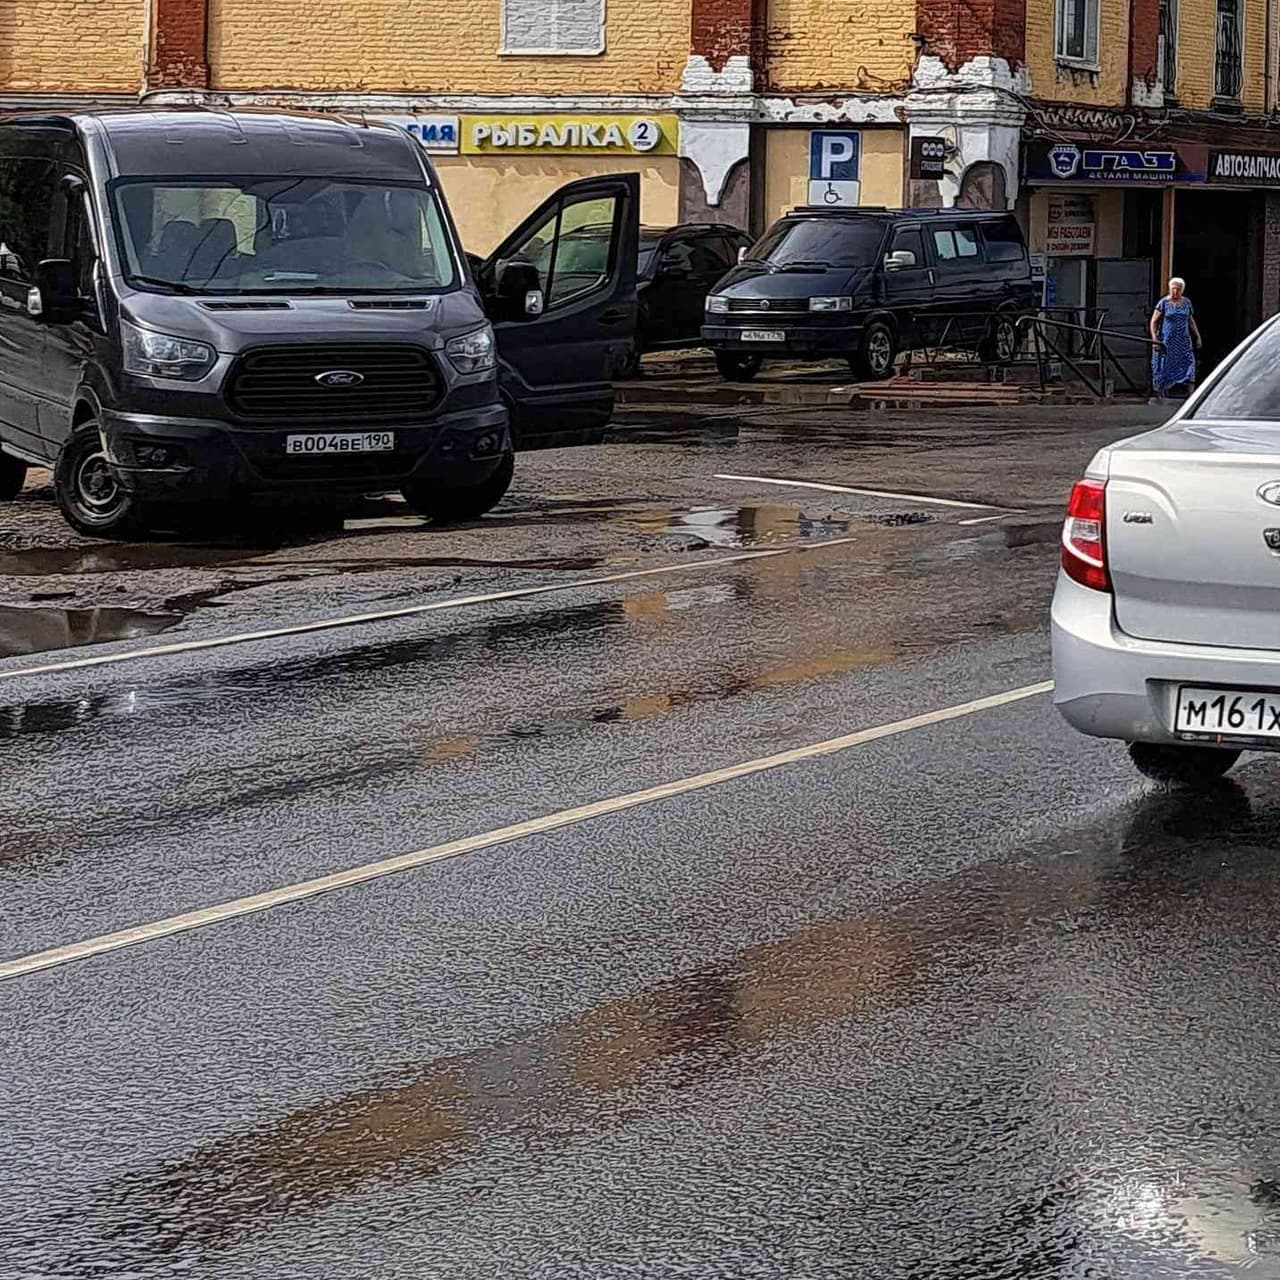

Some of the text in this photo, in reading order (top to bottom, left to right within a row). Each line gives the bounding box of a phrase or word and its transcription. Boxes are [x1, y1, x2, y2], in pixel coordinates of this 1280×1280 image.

[473, 123, 625, 148] РЫБАЛКА
[636, 122, 649, 139] 2
[821, 136, 854, 178] P
[1083, 150, 1176, 171] ГАЗ
[365, 433, 390, 446] 190
